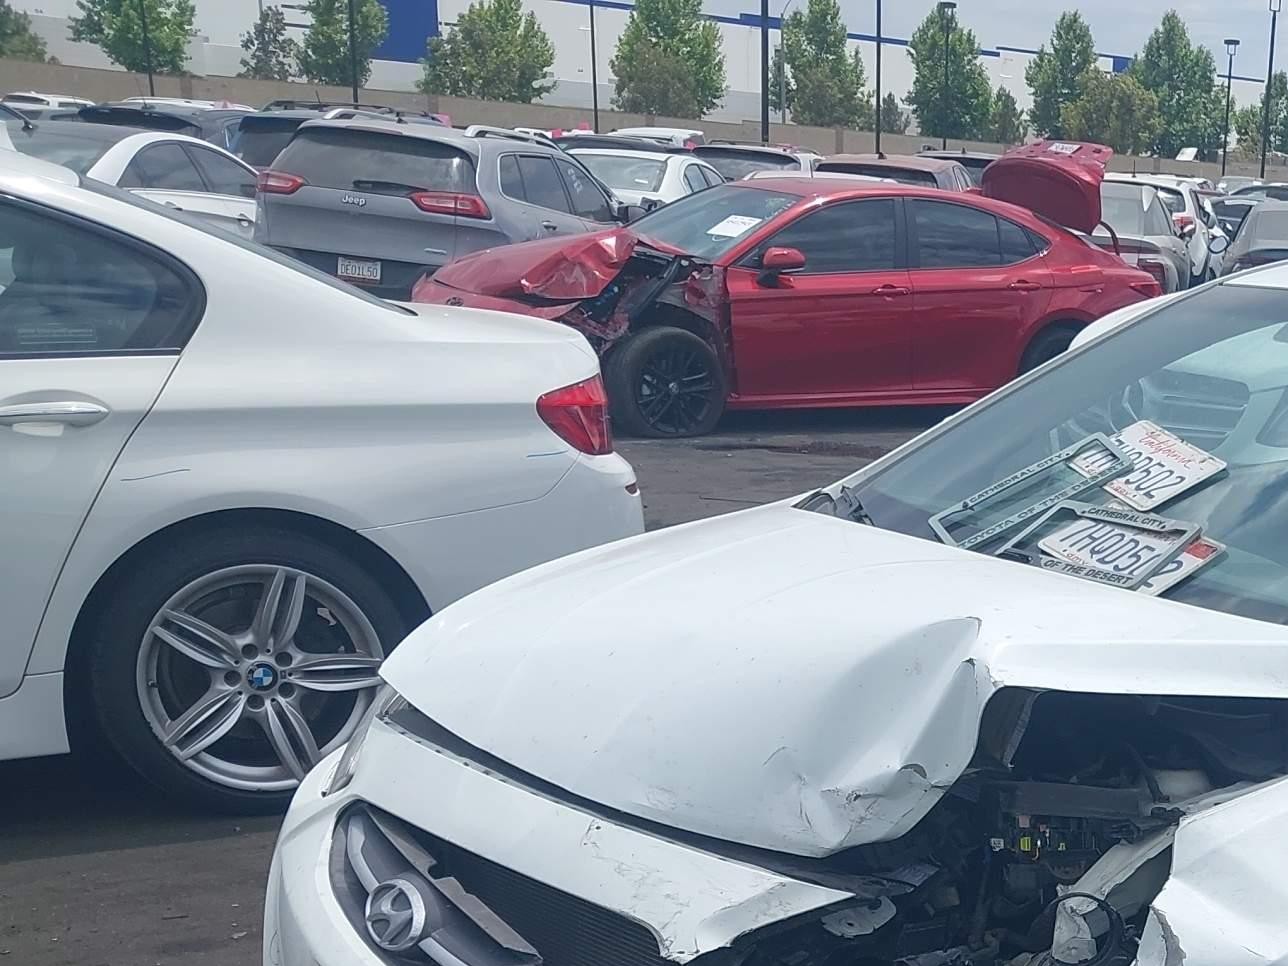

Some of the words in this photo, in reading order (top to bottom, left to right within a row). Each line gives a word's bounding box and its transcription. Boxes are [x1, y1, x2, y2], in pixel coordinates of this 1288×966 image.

[342, 195, 366, 207] Jeep
[1139, 431, 1192, 469] California
[969, 468, 1036, 504] CATHEDRAL
[1037, 453, 1063, 469] CITY
[960, 519, 1014, 548] TOYOTA
[1017, 507, 1036, 519] OF
[1039, 491, 1068, 507] THE
[1072, 460, 1125, 490] DESERT
[1087, 507, 1139, 523] CATHEDRAL
[1141, 518, 1163, 528] CITY
[1044, 560, 1062, 568] OF
[1062, 563, 1087, 574] THE
[1085, 569, 1134, 584] DESERT
